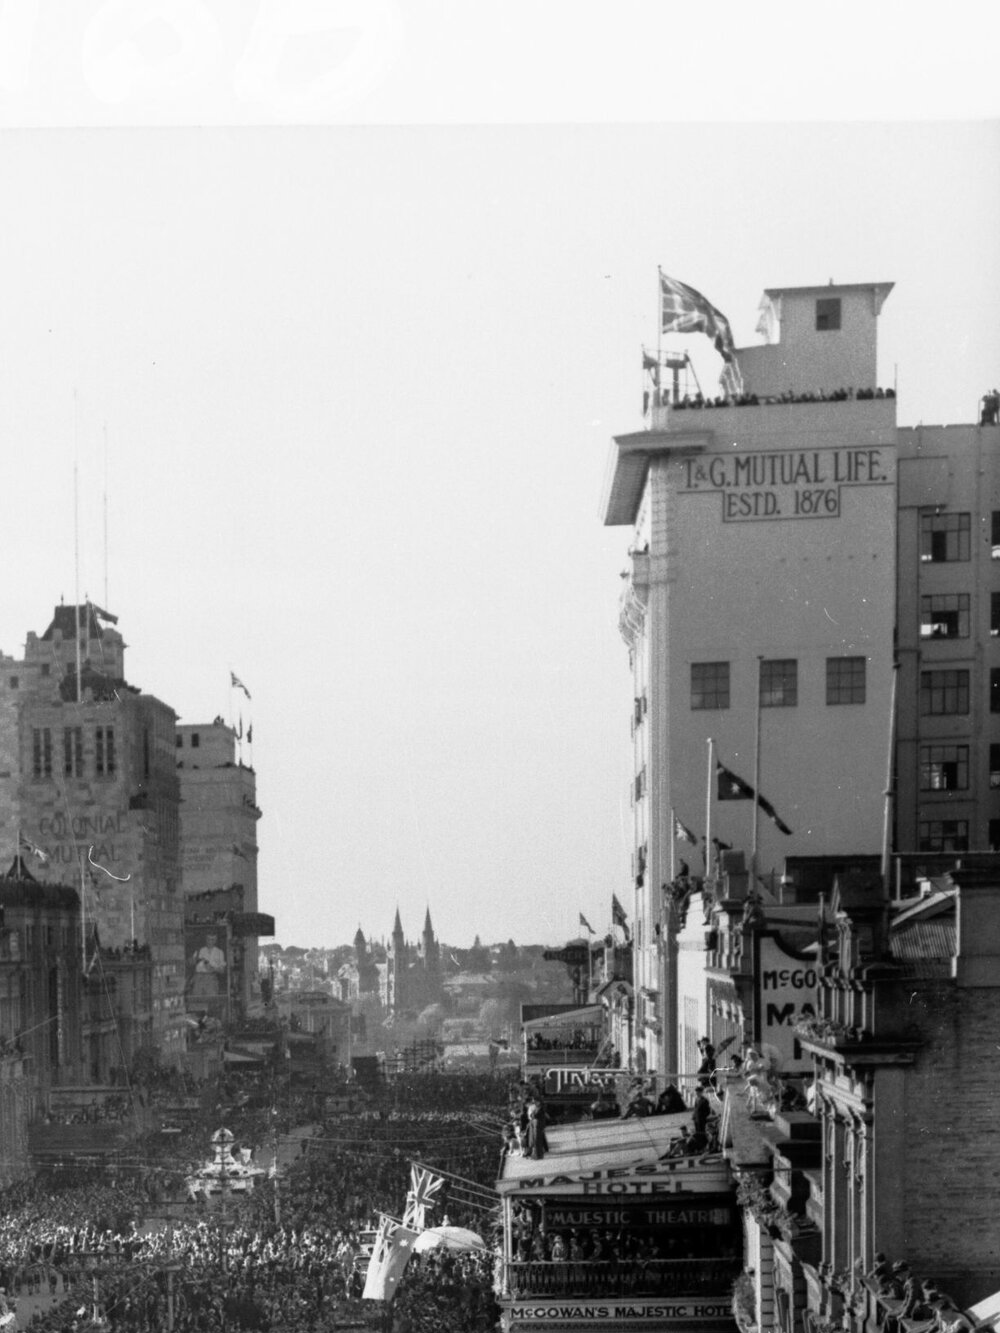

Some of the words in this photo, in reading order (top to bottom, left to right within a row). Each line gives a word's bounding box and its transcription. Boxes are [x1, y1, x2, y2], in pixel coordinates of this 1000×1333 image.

[734, 453, 825, 487] MUTUAL
[833, 451, 887, 482] LIFE.
[726, 492, 781, 517] ESTD.
[794, 489, 837, 514] 1876
[39, 813, 125, 835] COLONIAL
[518, 1156, 724, 1189] MAJESTIC
[583, 1181, 693, 1195] HOTEL
[552, 1211, 631, 1225] MAJESTIC
[511, 1306, 609, 1319] McGOWAN'S
[614, 1306, 687, 1317] MAJESTIC
[694, 1305, 733, 1316] HOTE
